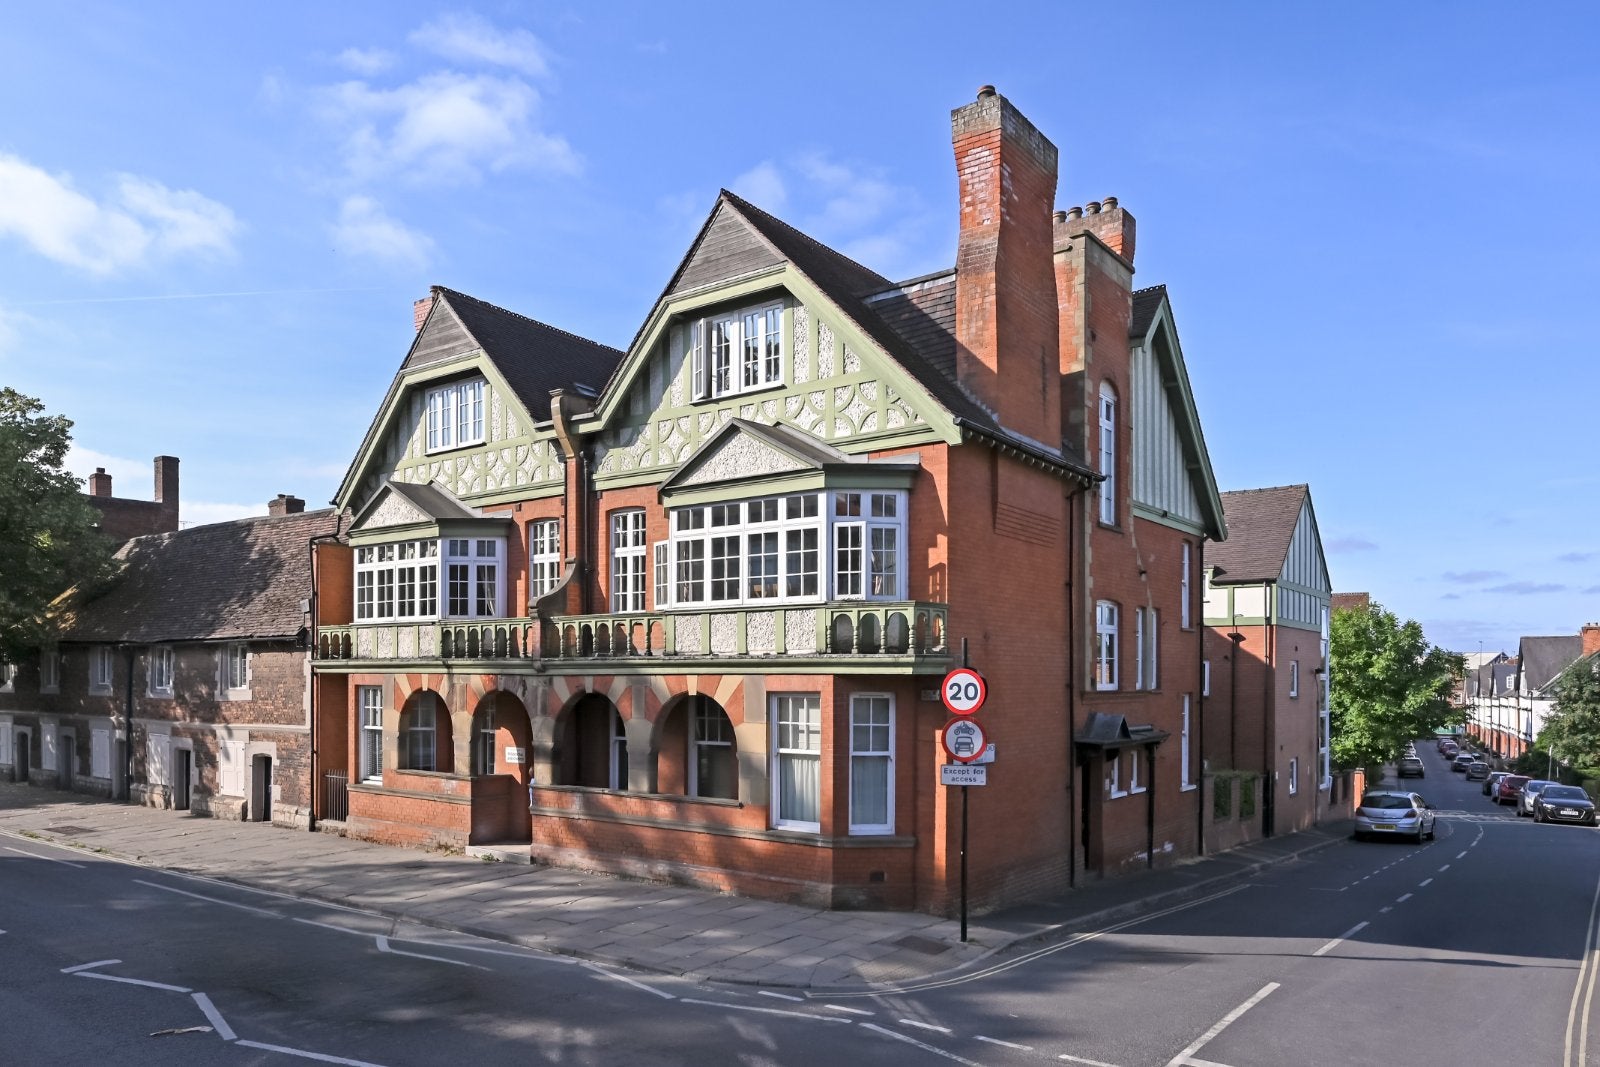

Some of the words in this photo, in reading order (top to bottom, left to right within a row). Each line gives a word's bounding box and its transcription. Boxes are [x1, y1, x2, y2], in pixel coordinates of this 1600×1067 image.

[949, 682, 979, 701] 20
[943, 767, 970, 775] Except
[973, 767, 984, 775] for
